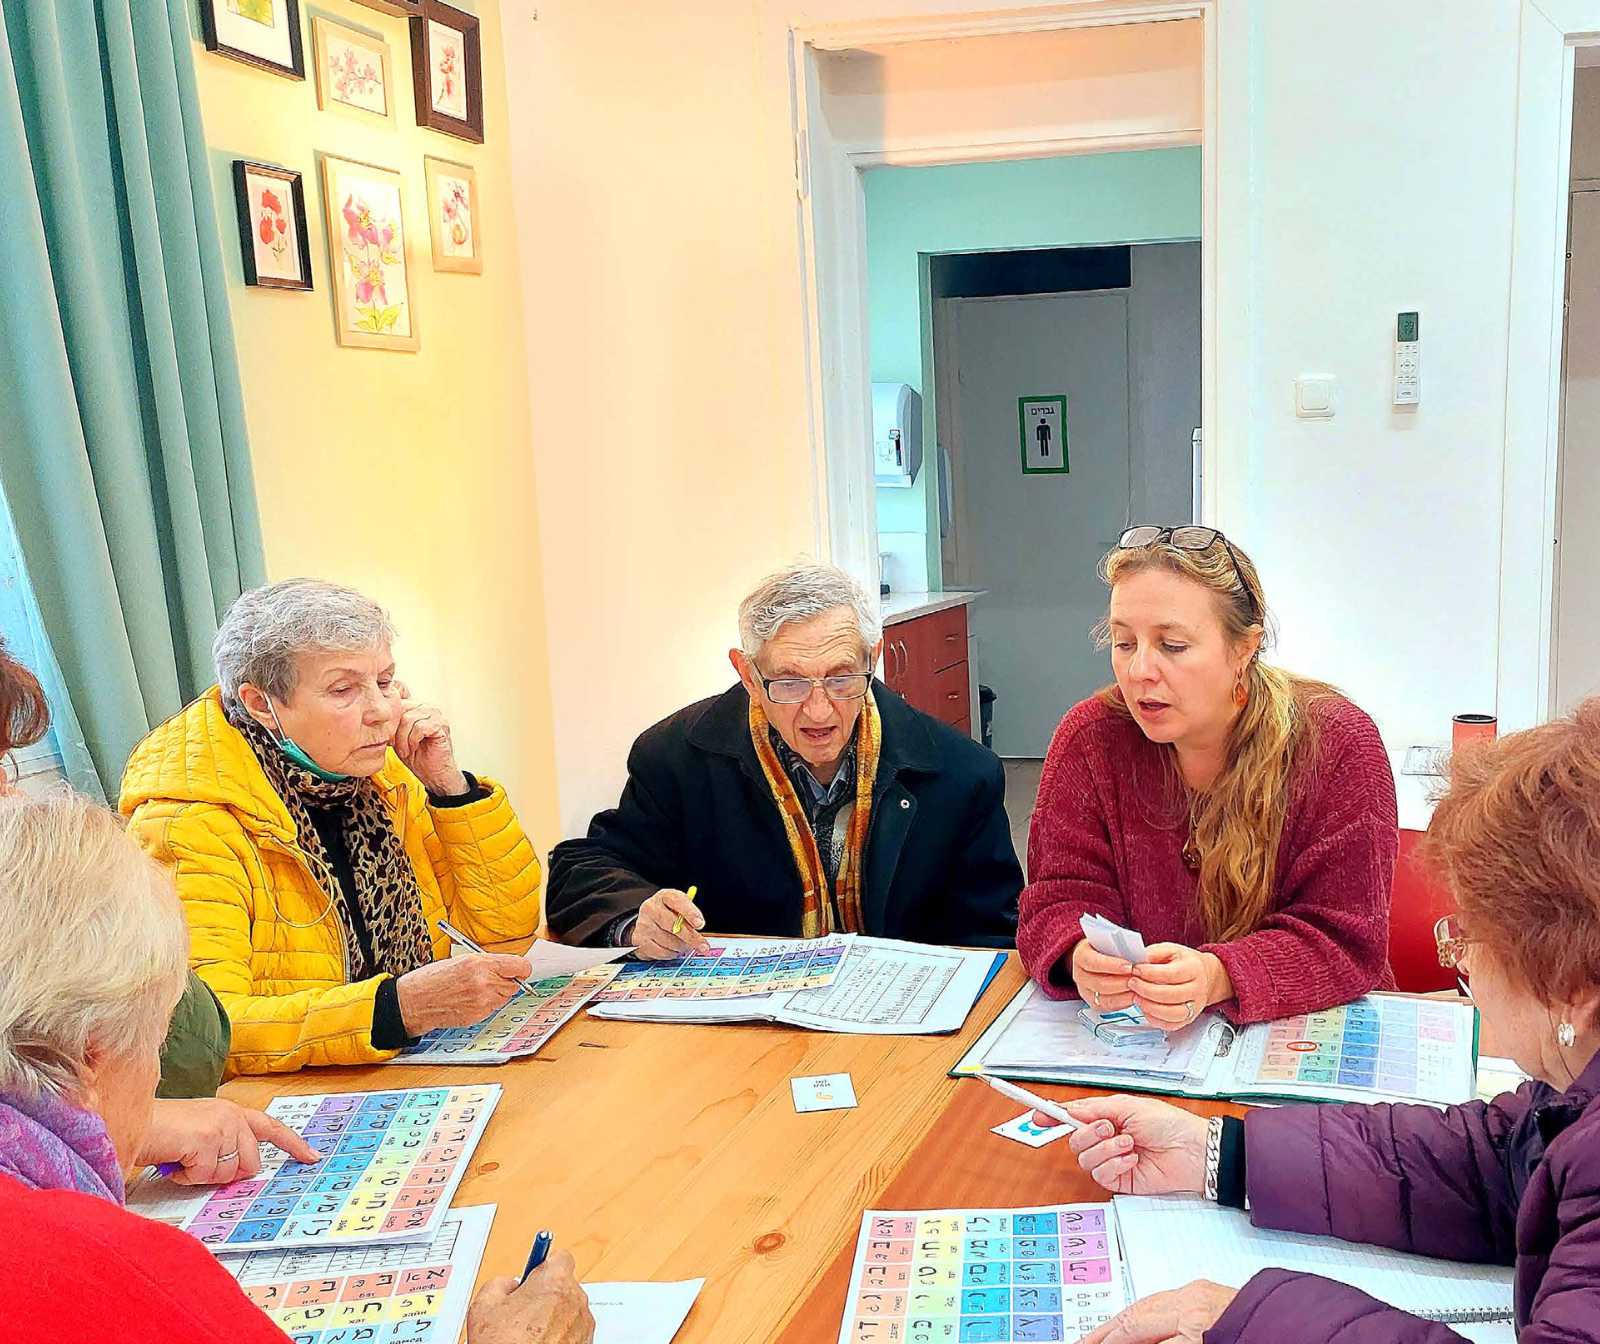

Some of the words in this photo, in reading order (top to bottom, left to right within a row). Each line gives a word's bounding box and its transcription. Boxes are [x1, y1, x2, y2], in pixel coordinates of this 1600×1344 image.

[1030, 407, 1055, 416] גברים
[877, 1219, 895, 1228] א
[426, 1268, 445, 1280] א
[319, 1280, 337, 1292] ב
[264, 1286, 277, 1299] ג
[362, 1302, 382, 1313] ח
[304, 1308, 325, 1319] ט
[414, 1319, 431, 1333] ל
